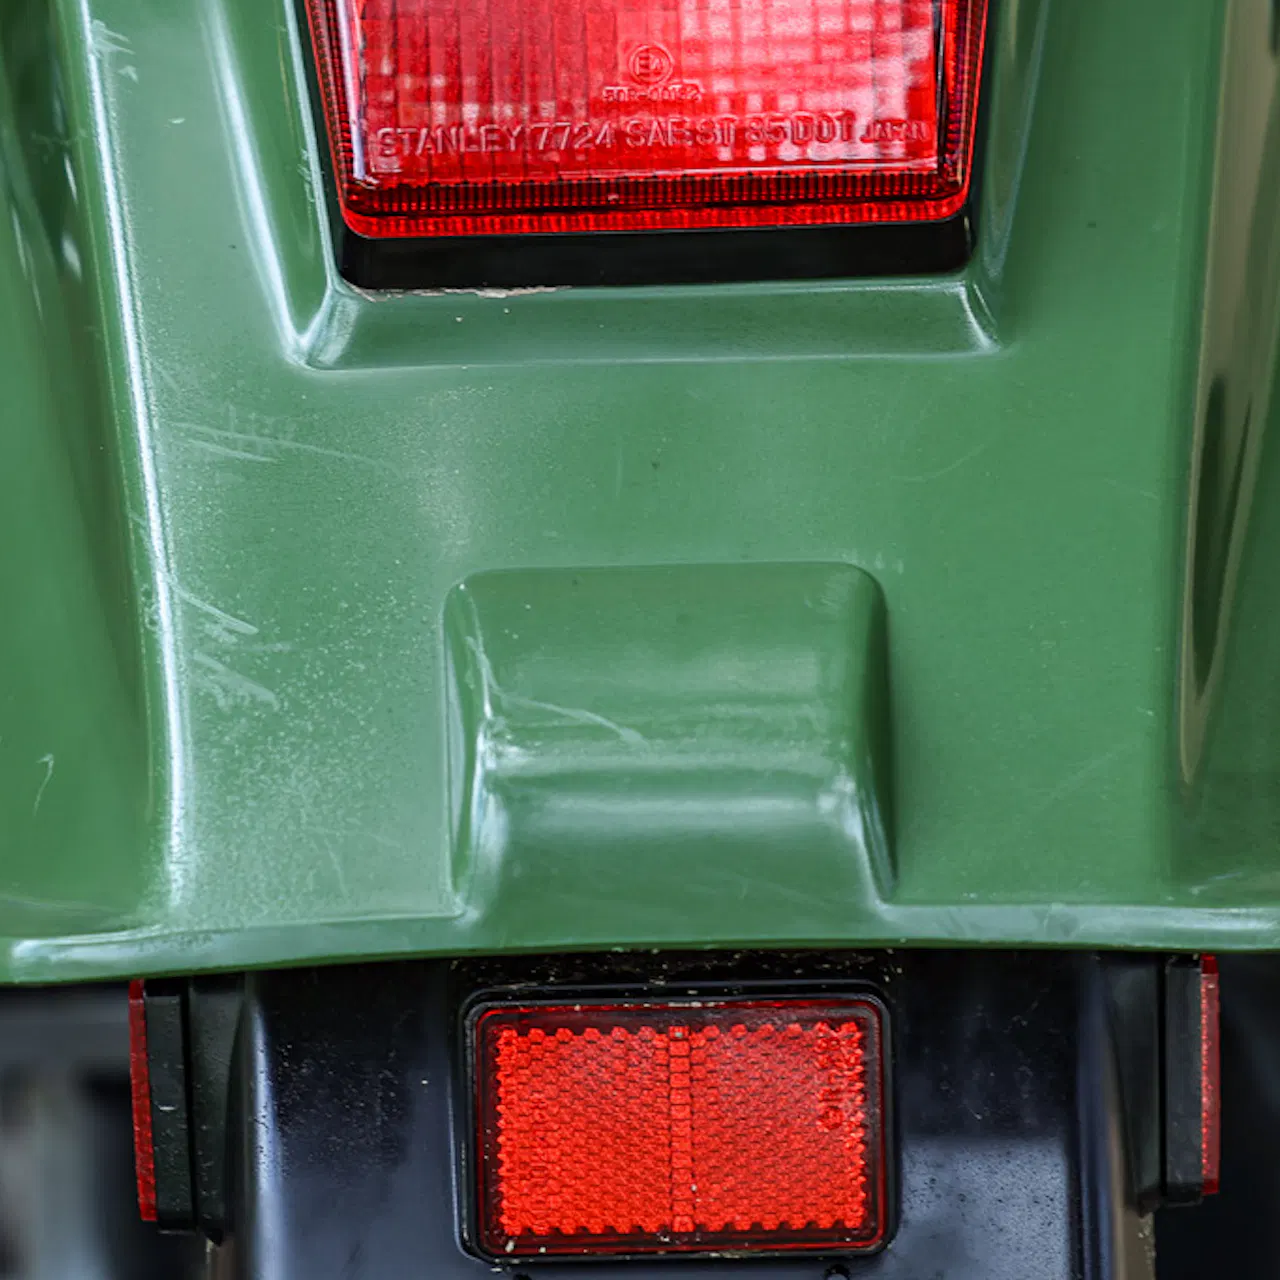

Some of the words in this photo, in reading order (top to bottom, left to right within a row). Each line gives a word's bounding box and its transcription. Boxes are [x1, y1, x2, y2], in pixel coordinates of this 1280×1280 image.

[376, 124, 522, 157] STANLEY
[530, 122, 616, 151] 7724
[624, 117, 692, 148] SAE
[790, 110, 856, 144] DOT
